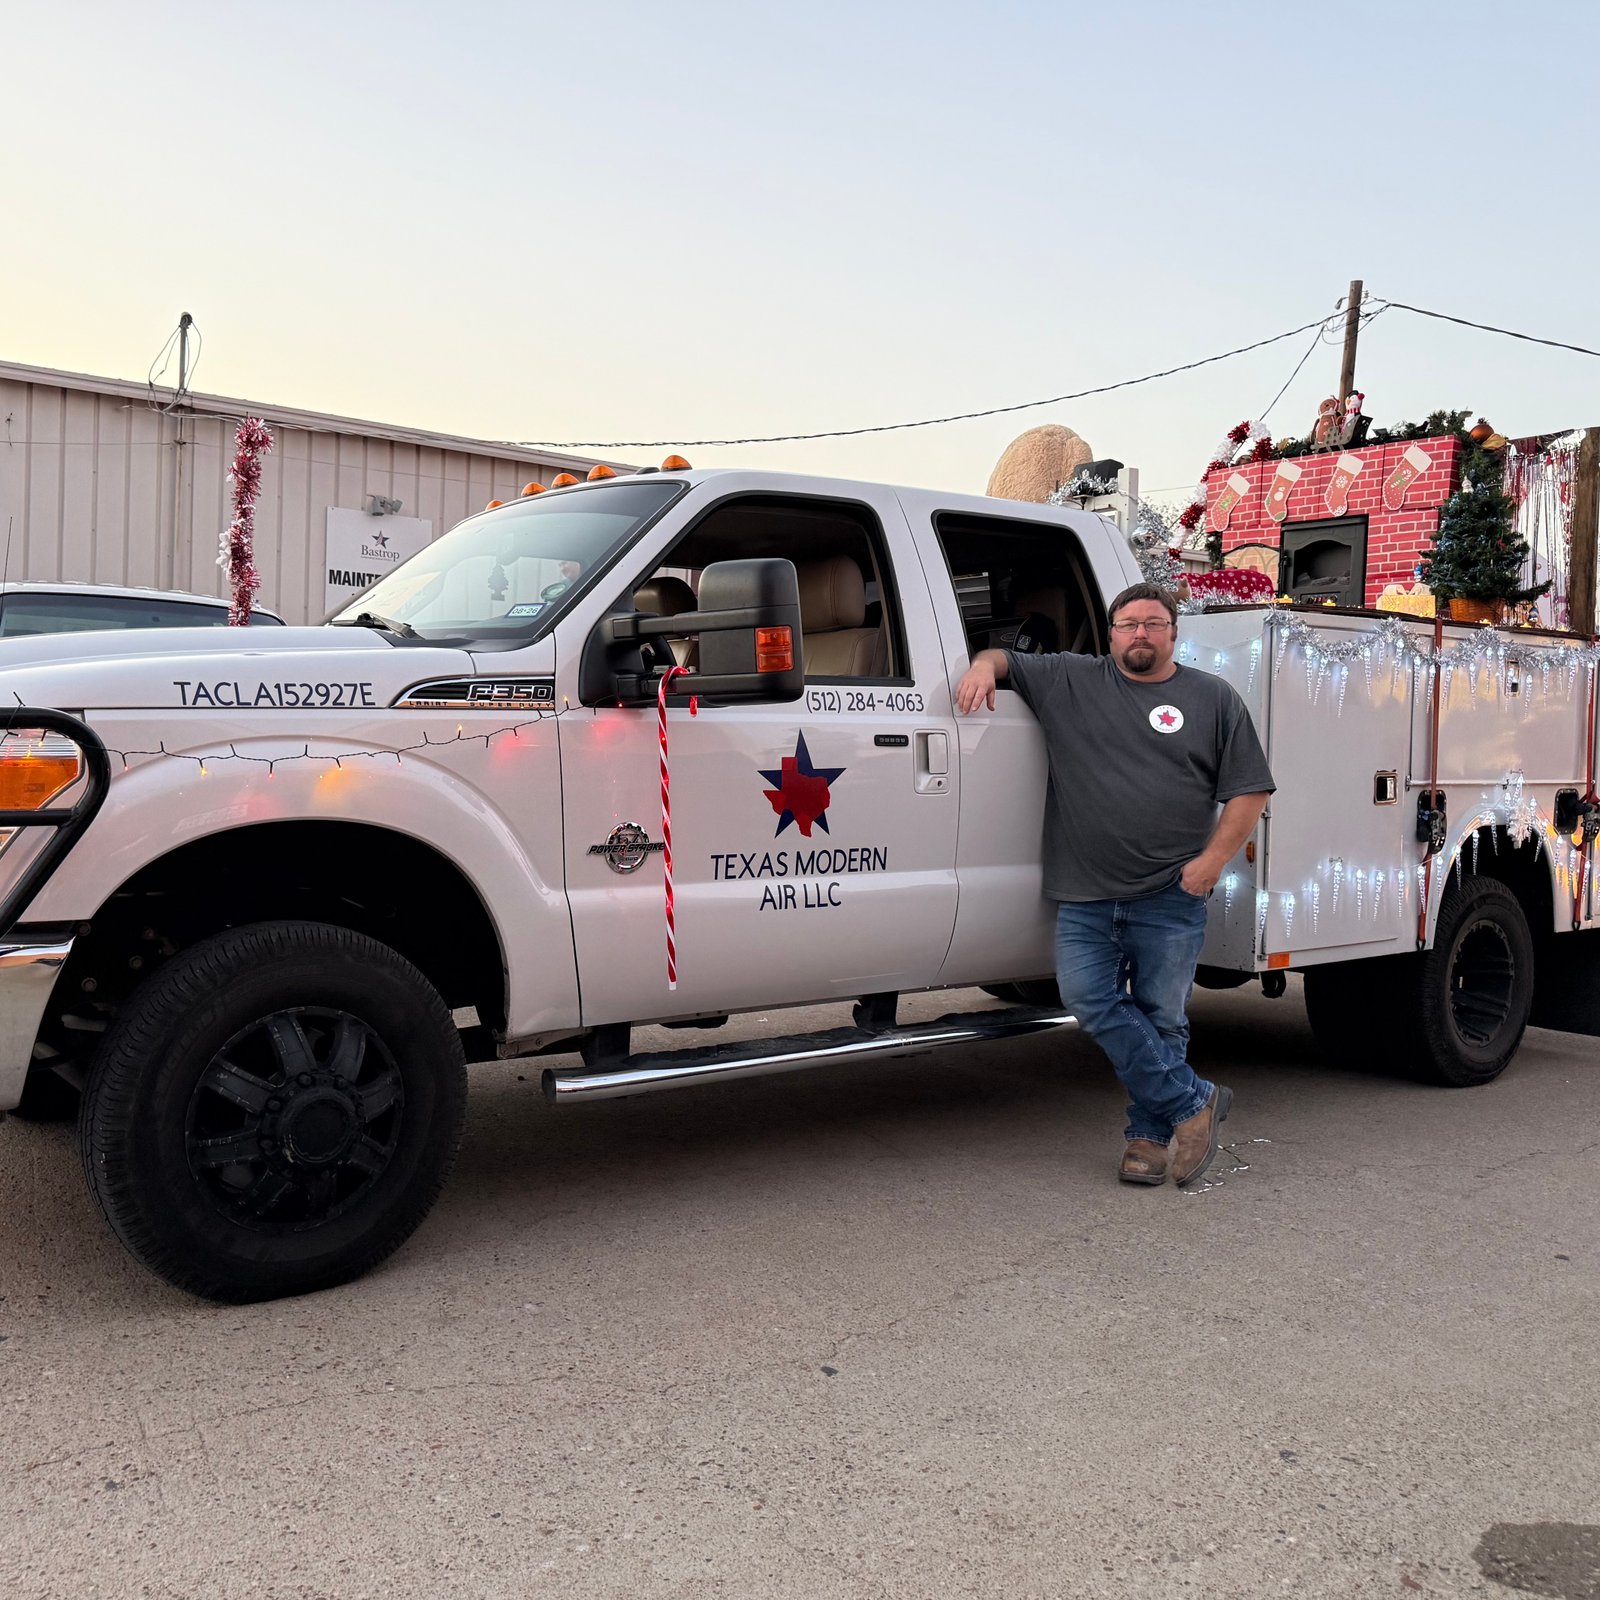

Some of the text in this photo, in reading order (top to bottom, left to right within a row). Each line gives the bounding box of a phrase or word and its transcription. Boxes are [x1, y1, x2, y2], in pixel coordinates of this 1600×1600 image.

[361, 544, 400, 562] Bastrop
[173, 681, 376, 706] TACLA152927E
[806, 690, 924, 714] (512) 284-4063
[588, 842, 666, 855] POWER STROKE
[710, 846, 888, 880] TEXAS MODERN
[759, 882, 842, 911] AIR LLC
